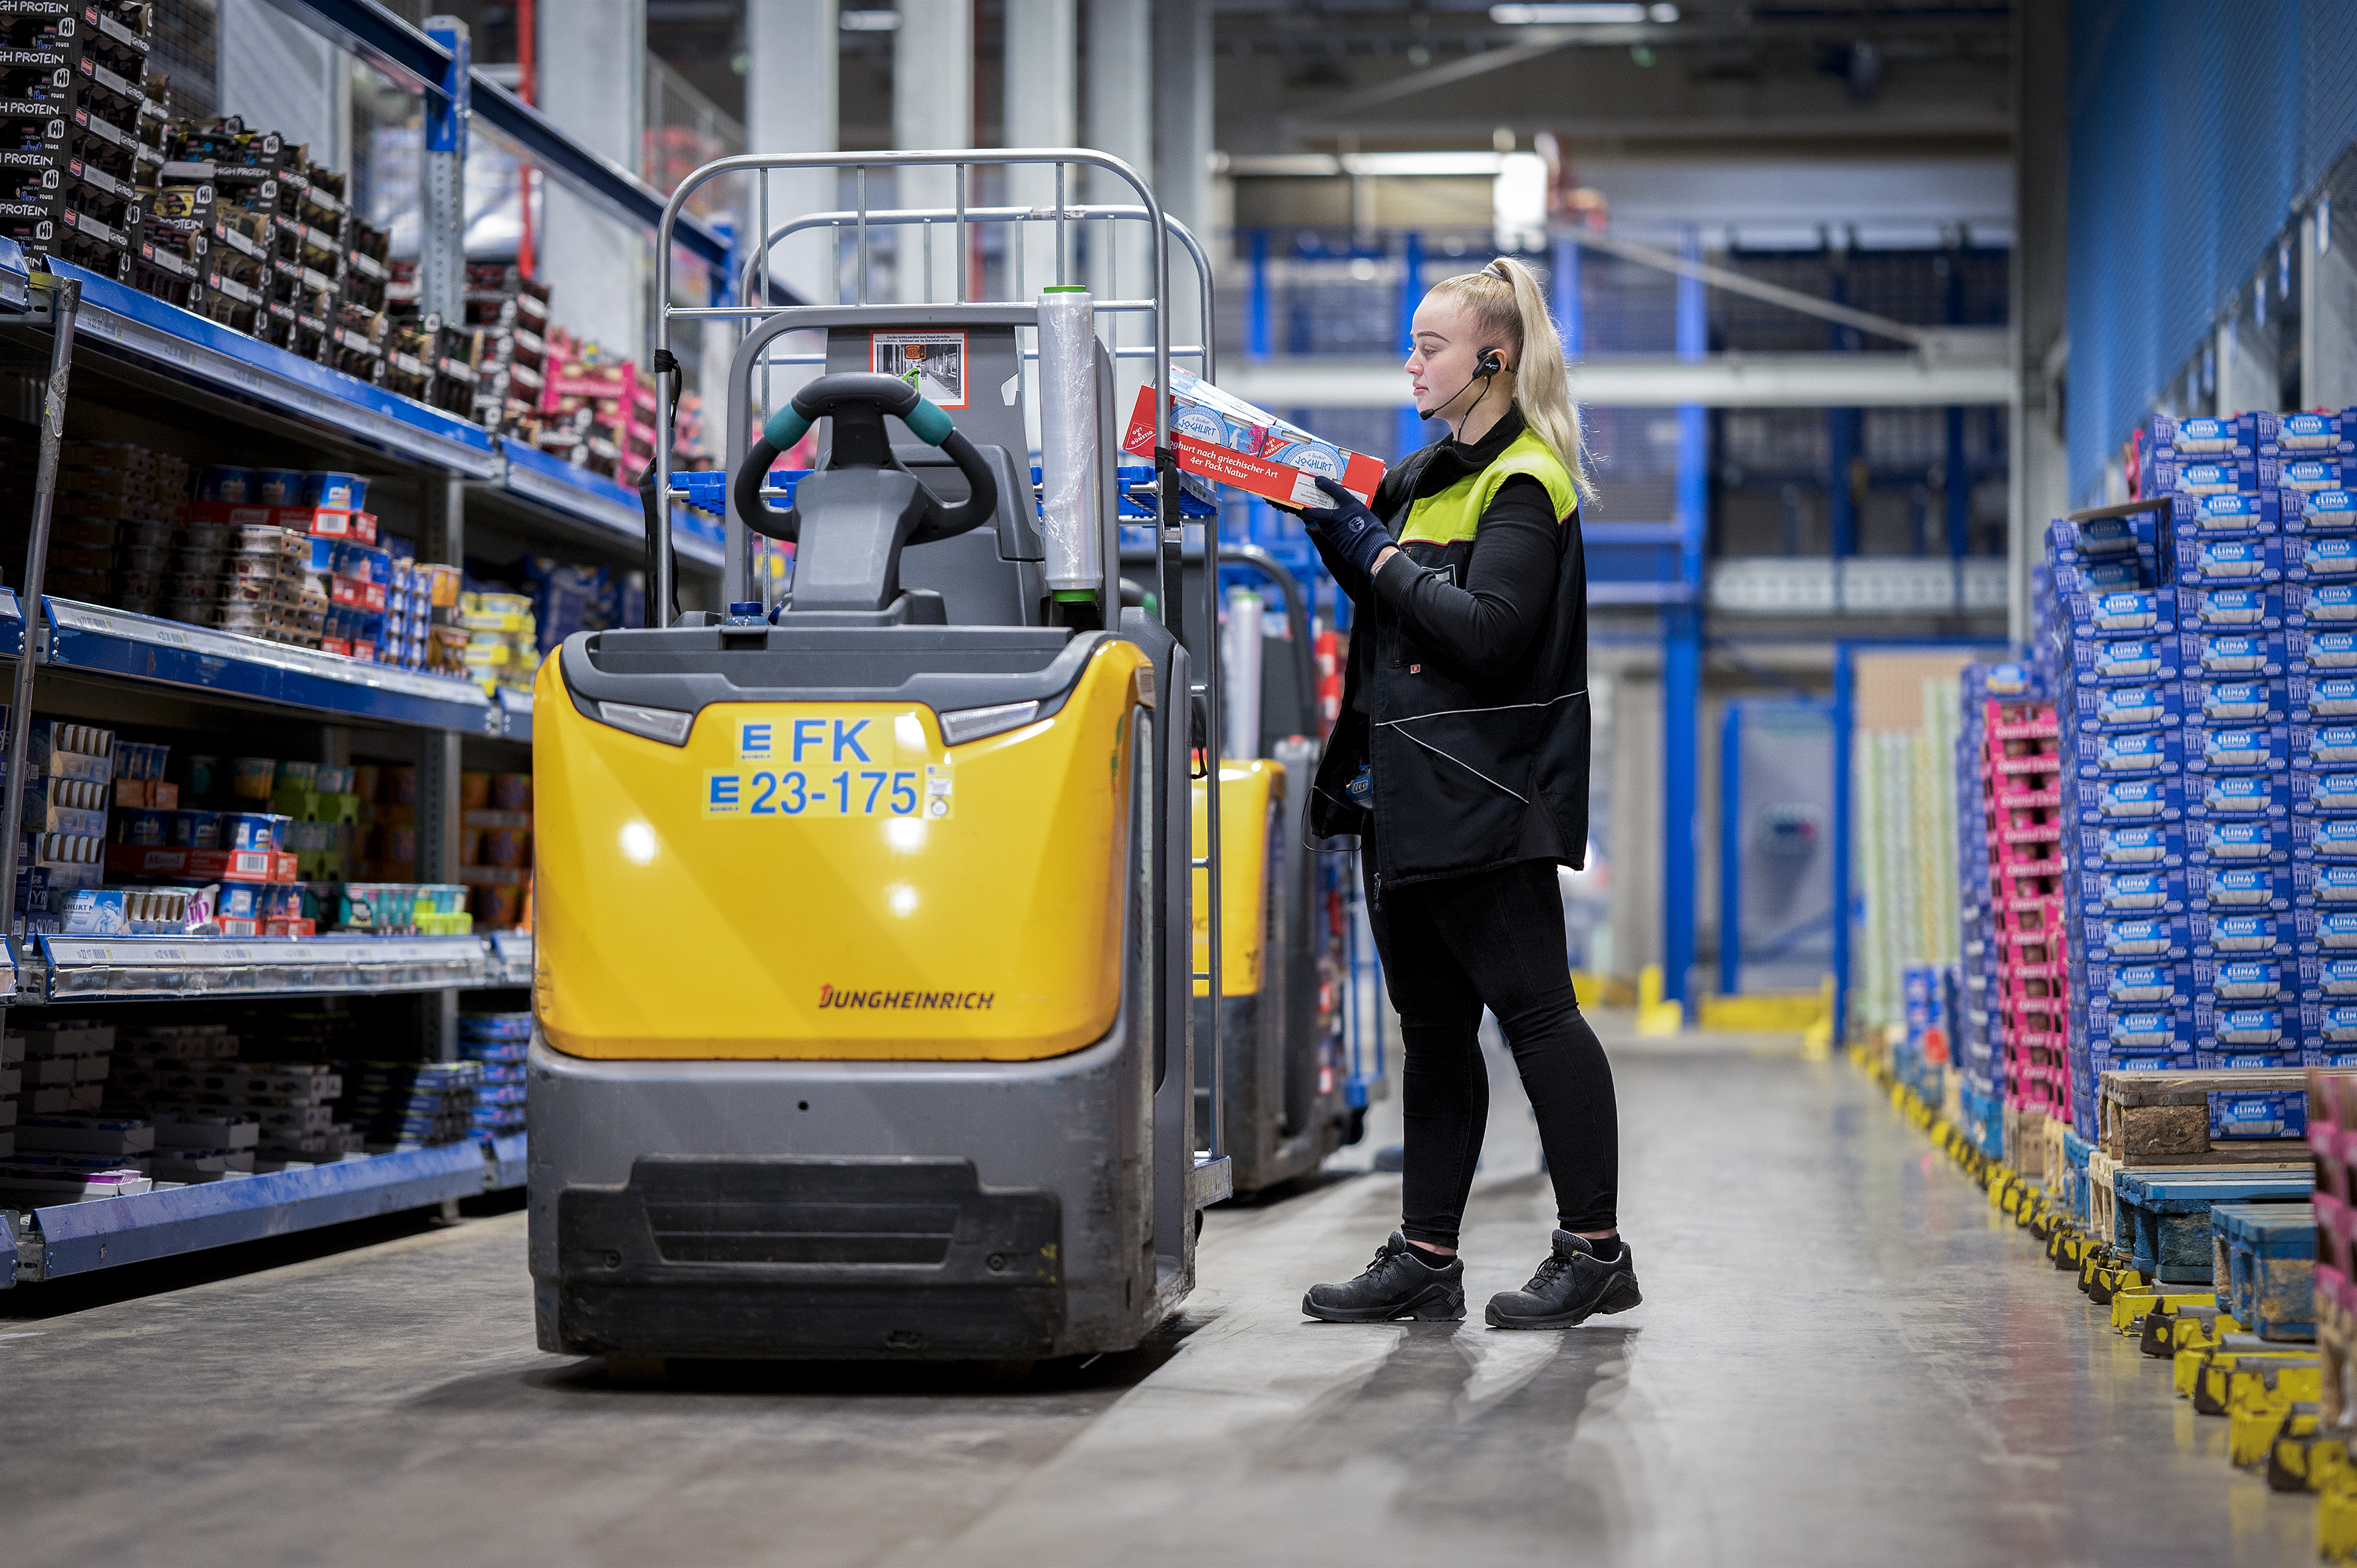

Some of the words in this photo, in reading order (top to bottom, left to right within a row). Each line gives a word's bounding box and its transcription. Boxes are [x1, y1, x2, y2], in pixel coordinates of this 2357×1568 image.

[20, 1, 69, 13] PROTEIN
[15, 51, 64, 64] PROTEIN
[10, 102, 59, 115] PROTEIN
[5, 153, 53, 166] PROTEIN
[214, 168, 236, 176] HIGH
[236, 168, 271, 177] PROTEIN
[0, 204, 48, 216] PROTEIN
[1179, 419, 1217, 436] JOGHURT
[2186, 424, 2219, 434] ELINAS
[2290, 420, 2323, 430] ELINAS
[1132, 426, 1144, 435] GUT
[1131, 430, 1154, 445] GÜNSTIG
[1265, 442, 1285, 455] GÜNSTIG
[1170, 440, 1195, 453] oghurt
[1197, 448, 1216, 459] nach
[1217, 456, 1264, 474] griechischer
[1265, 468, 1279, 478] Art
[1295, 456, 1333, 472] JOGHURT
[1190, 456, 1203, 466] 4er
[1205, 460, 1223, 472] Pack
[1224, 466, 1248, 479] Natur
[2291, 466, 2324, 475] ELINAS
[2187, 469, 2221, 479] ELINAS
[2208, 500, 2241, 510] ELINAS
[2315, 496, 2348, 506] ELINAS
[2211, 546, 2245, 556] ELINAS
[2317, 543, 2350, 552] ELINAS
[2214, 593, 2247, 603] ELINAS
[2318, 589, 2352, 599] ELINAS
[2105, 599, 2138, 608] ELINAS
[2215, 641, 2249, 651] ELINAS
[2320, 637, 2353, 647] ELINAS
[2110, 645, 2143, 655] ELINAS
[2217, 688, 2250, 697] ELINAS
[2322, 684, 2355, 693] ELINAS
[2112, 693, 2145, 703] ELINAS
[792, 719, 873, 763] FK
[2217, 734, 2251, 744] ELINAS
[2322, 731, 2356, 741] ELINAS
[2114, 739, 2147, 749] ELINAS
[2221, 781, 2254, 790] ELINAS
[750, 770, 917, 815] 23-175
[2114, 786, 2147, 796] ELINAS
[2116, 832, 2149, 842] ELINAS
[2221, 828, 2254, 837] ELINAS
[2117, 878, 2150, 887] ELINAS
[2223, 874, 2256, 883] ELINAS
[2118, 925, 2151, 934] ELINAS
[2223, 921, 2257, 930] ELINAS
[2122, 971, 2155, 981] ELINAS
[2227, 967, 2260, 977] ELINAS
[818, 984, 995, 1009] JUNGHEINRICH
[2124, 1017, 2157, 1026] ELINAS
[2231, 1014, 2264, 1023] ELINAS
[2233, 1105, 2267, 1115] ELINAS
